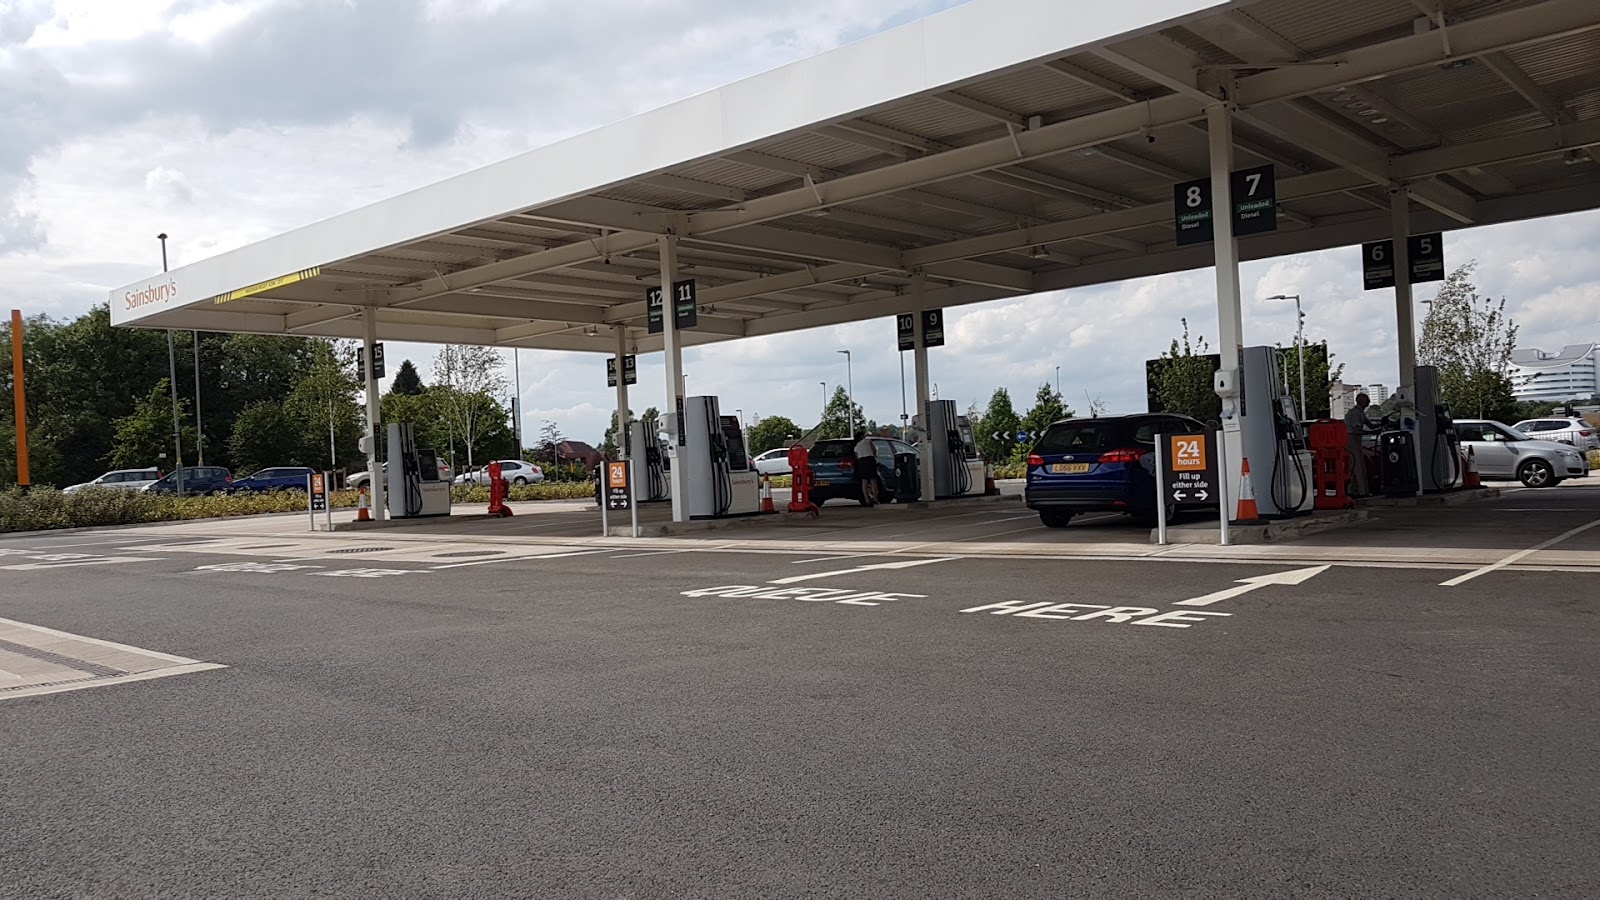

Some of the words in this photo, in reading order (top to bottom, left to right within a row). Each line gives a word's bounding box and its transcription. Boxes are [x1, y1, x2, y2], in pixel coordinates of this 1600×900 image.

[1246, 173, 1261, 196] 7
[1186, 186, 1202, 207] 8
[1240, 200, 1270, 211] Unleaded
[1181, 211, 1209, 221] Unleaded
[1240, 210, 1260, 220] Diesel
[1181, 221, 1200, 230] Diesel
[1372, 245, 1384, 261] 6
[1420, 238, 1432, 254] 5
[125, 278, 177, 311] Sainsbury's
[650, 290, 663, 307] 12
[678, 284, 692, 301] 11
[899, 316, 913, 330] 10
[930, 313, 938, 326] 9
[373, 346, 383, 359] 15
[625, 358, 635, 369] 13
[1176, 440, 1200, 458] 24
[1177, 458, 1201, 466] hours
[612, 465, 623, 479] 24
[1179, 472, 1190, 480] Fill
[1191, 473, 1201, 481] up
[1172, 481, 1193, 489] either
[1193, 480, 1209, 488] side
[680, 585, 930, 606] QUEUE
[959, 600, 1233, 628] HERE
